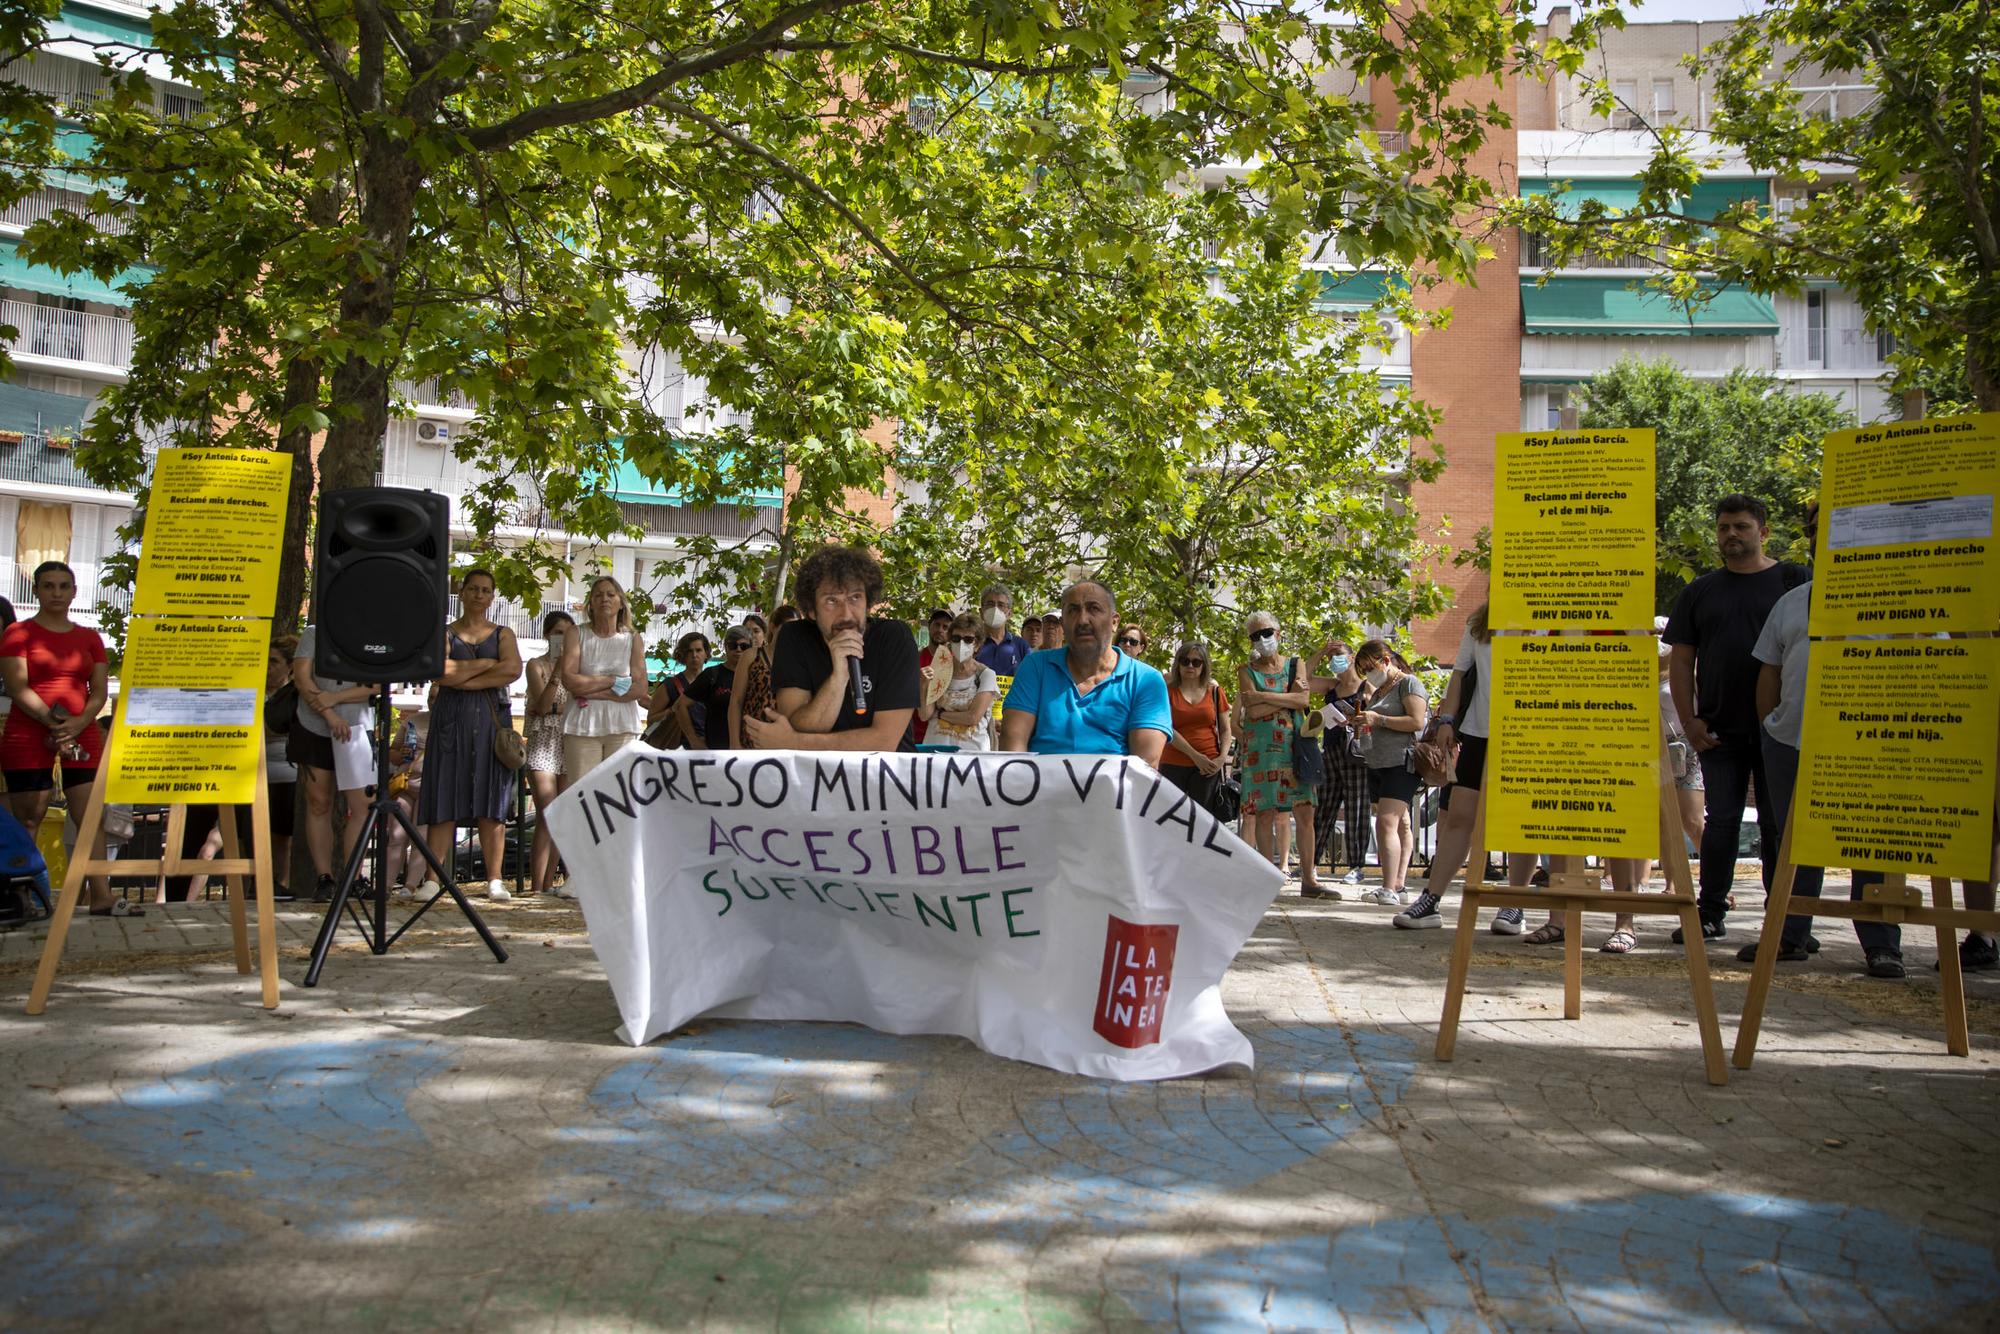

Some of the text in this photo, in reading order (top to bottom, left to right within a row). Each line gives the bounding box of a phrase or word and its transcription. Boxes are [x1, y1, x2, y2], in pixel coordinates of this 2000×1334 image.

[1855, 421, 1976, 444] #Soy Antonia García.
[1524, 434, 1629, 448] #Soy Antonia García.
[181, 452, 271, 465] #Soy Antonia García.
[170, 495, 269, 508] Reclamé mis derechos.
[1524, 490, 1627, 502] Reclamo mi derecho
[1539, 505, 1613, 518] y el de mi hija.
[1833, 544, 1985, 564] Reclamo nuestro derecho
[175, 573, 244, 583] #IMV DIGNO YA.
[1532, 610, 1613, 620] #IMV DIGNO YA.
[1856, 608, 1950, 622] #IMV DIGNO YA.
[154, 623, 248, 634] #Soy Antonia García.
[1521, 642, 1632, 654] #Soy Antonia García.
[1842, 645, 1969, 659] #Soy Antonia García.
[1514, 699, 1637, 711] Reclamé mis derechos.
[1839, 711, 1963, 724] Reclamo mi derecho
[130, 729, 248, 739] Reclamo nuestro derecho
[1856, 728, 1944, 742] y el de mi hija.
[147, 782, 220, 792] #IMV DIGNO YA.
[577, 756, 790, 846] INGRESO
[1531, 799, 1616, 813] #IMV DIGNO YA.
[1841, 846, 1938, 865] #IMV DIGNO YA.
[703, 868, 1041, 938] SUFICIENTE
[1124, 944, 1157, 969] LA
[1117, 974, 1164, 998] ATE
[1112, 1001, 1156, 1028] NEA
